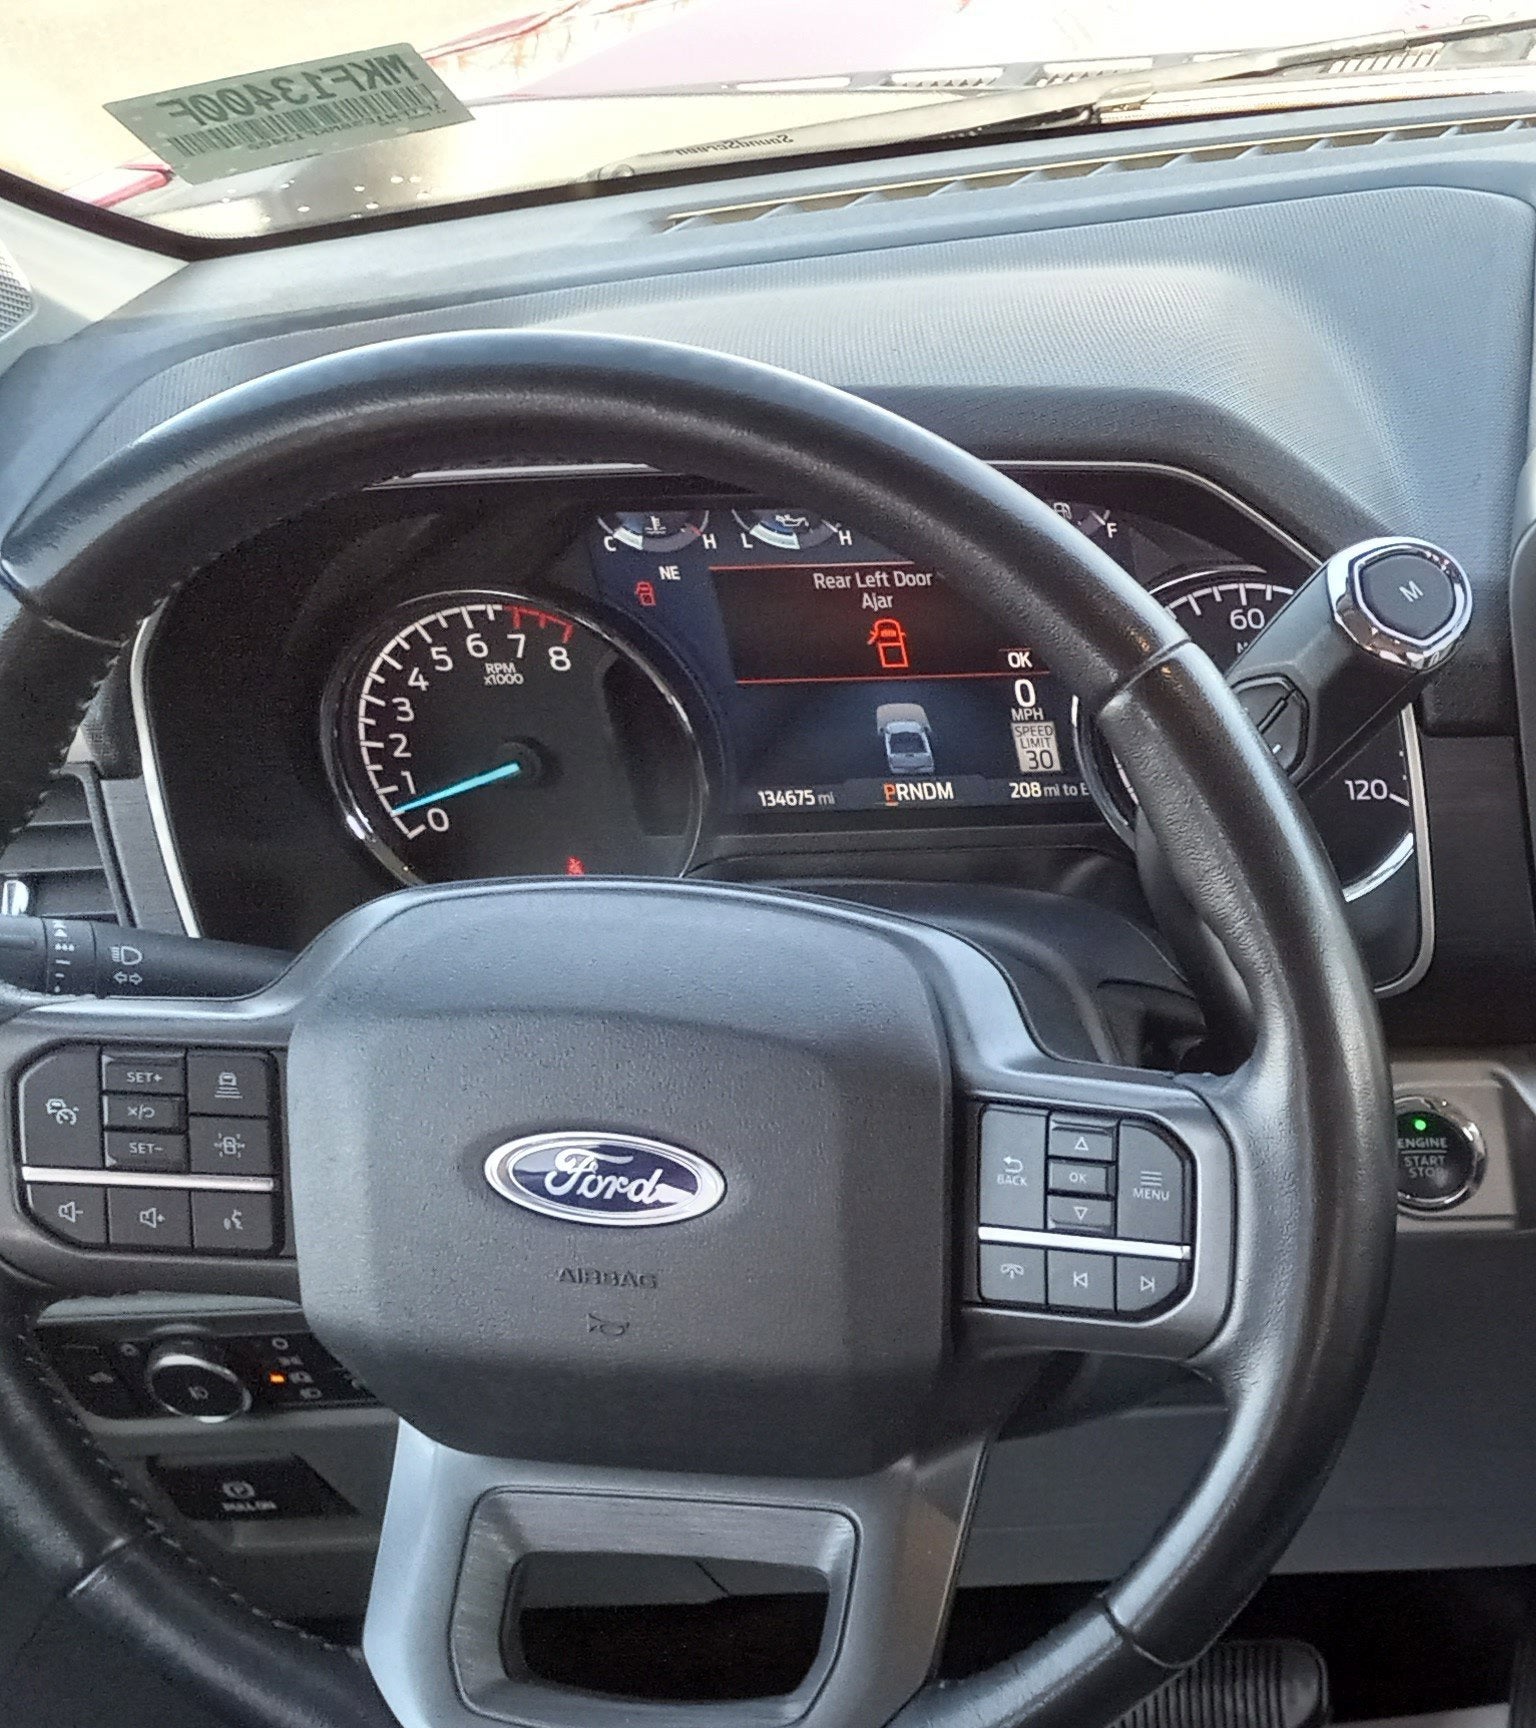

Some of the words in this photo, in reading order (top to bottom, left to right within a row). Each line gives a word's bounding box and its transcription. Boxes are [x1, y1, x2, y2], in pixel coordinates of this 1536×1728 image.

[838, 530, 852, 545] H
[1106, 522, 1118, 538] F
[603, 535, 617, 551] C
[702, 534, 717, 549] H
[740, 534, 753, 548] L
[658, 565, 681, 580] NE
[812, 573, 850, 590] Rear
[855, 571, 889, 588] Left
[895, 571, 932, 587] Door
[1399, 580, 1425, 603] M
[861, 592, 893, 611] Ajar
[1230, 608, 1266, 631] 60
[466, 633, 489, 659] 6
[506, 633, 526, 659] 7
[430, 646, 454, 672] 5
[548, 646, 572, 672] 8
[1007, 651, 1032, 669] OK
[485, 662, 517, 675] RPM
[407, 667, 430, 691] 4
[484, 673, 525, 686] x1000
[1014, 679, 1036, 708] 0
[391, 697, 415, 722] 3
[1011, 707, 1044, 722] MPH
[1015, 725, 1053, 737] SPEED
[388, 733, 412, 758] 2
[1020, 738, 1051, 749] LIMIT
[1026, 749, 1054, 770] 30
[401, 770, 416, 795] 1
[1009, 782, 1042, 798] 208
[1043, 785, 1060, 798] mi
[1062, 785, 1079, 797] to
[1345, 779, 1388, 802] 120
[758, 789, 816, 807] 134675
[818, 793, 835, 805] mi
[884, 781, 954, 806] PRNDM
[427, 807, 449, 833] 0
[1397, 1137, 1448, 1149] ENGINE
[1403, 1155, 1446, 1168] START
[545, 1147, 676, 1205] Ford
[996, 1175, 1028, 1187] BACK
[1068, 1171, 1087, 1184] OK
[1132, 1187, 1171, 1201] MENU
[558, 1266, 658, 1289] AIRBAG
